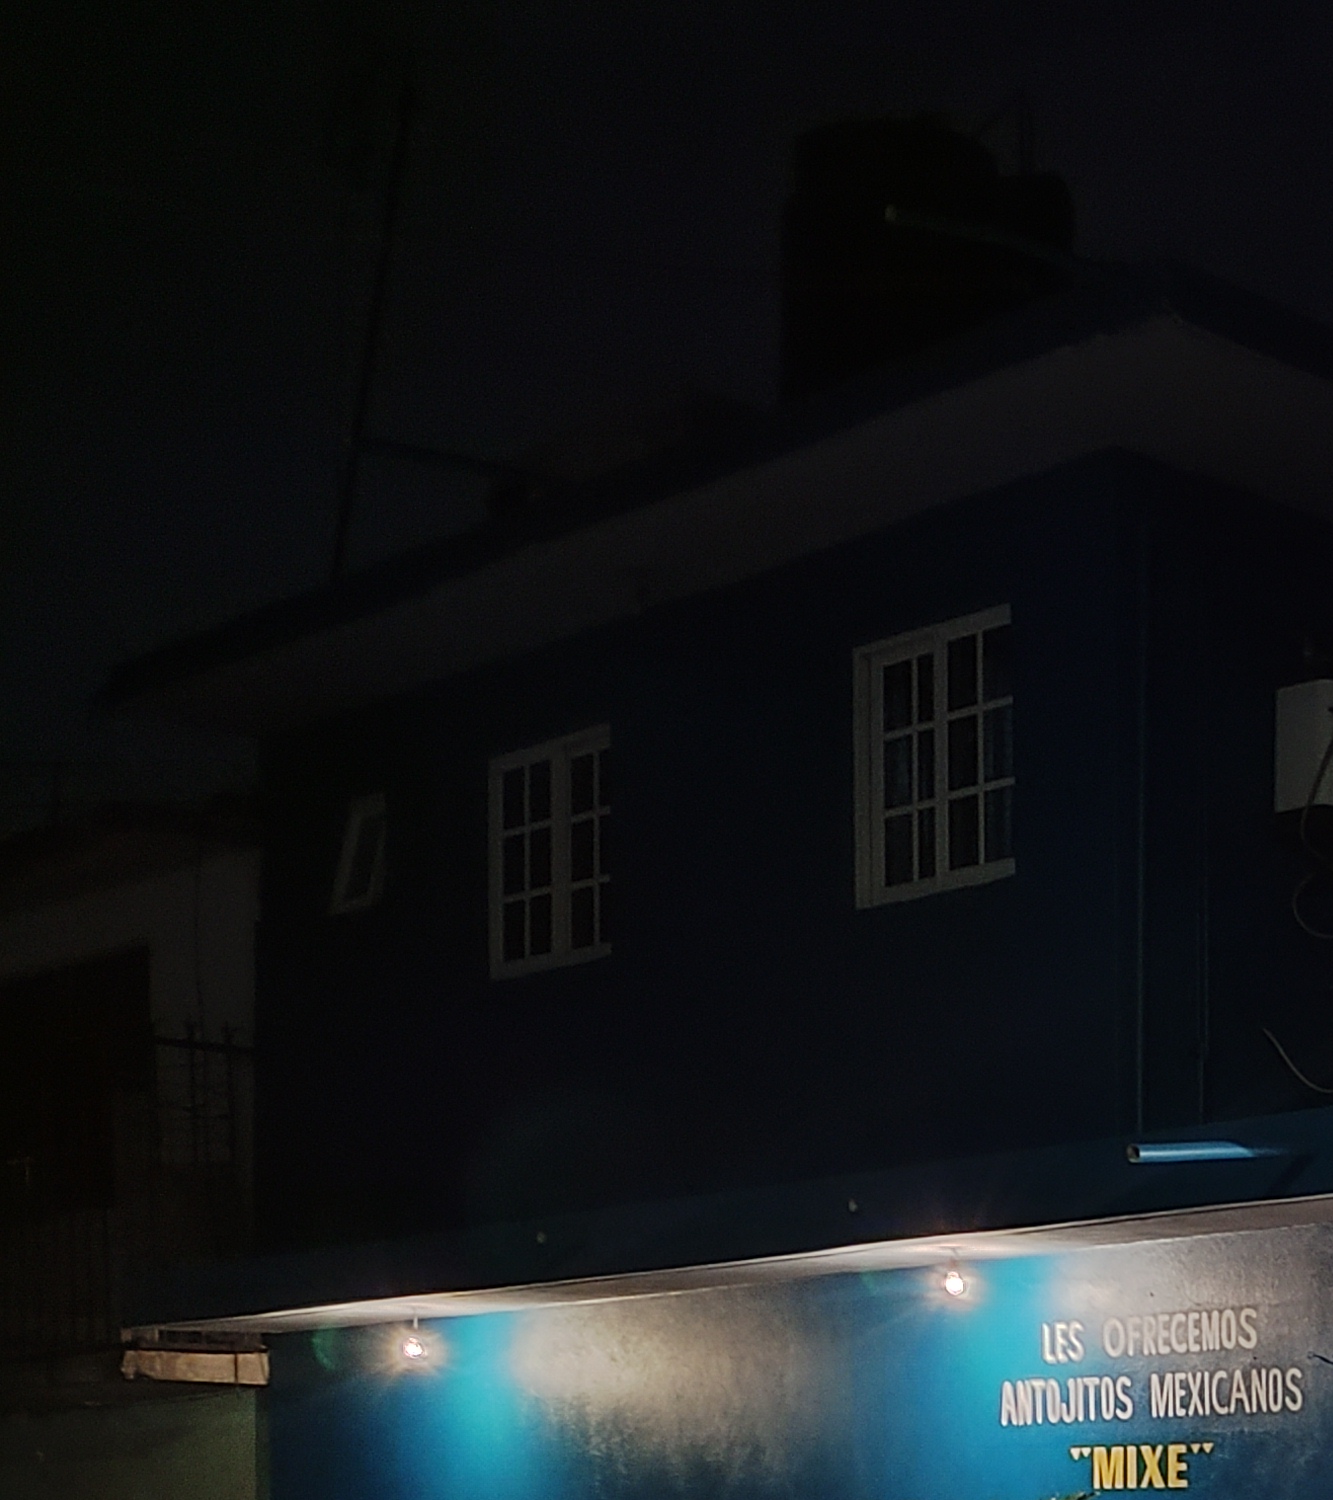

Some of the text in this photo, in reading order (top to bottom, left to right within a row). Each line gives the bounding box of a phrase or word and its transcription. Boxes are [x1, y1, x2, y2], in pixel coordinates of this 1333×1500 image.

[1040, 1307, 1258, 1365] LES OFRECEMOS
[1000, 1366, 1303, 1427] ANTOJITOS MEXICANOS
[1068, 1441, 1215, 1490] "MIXE"
